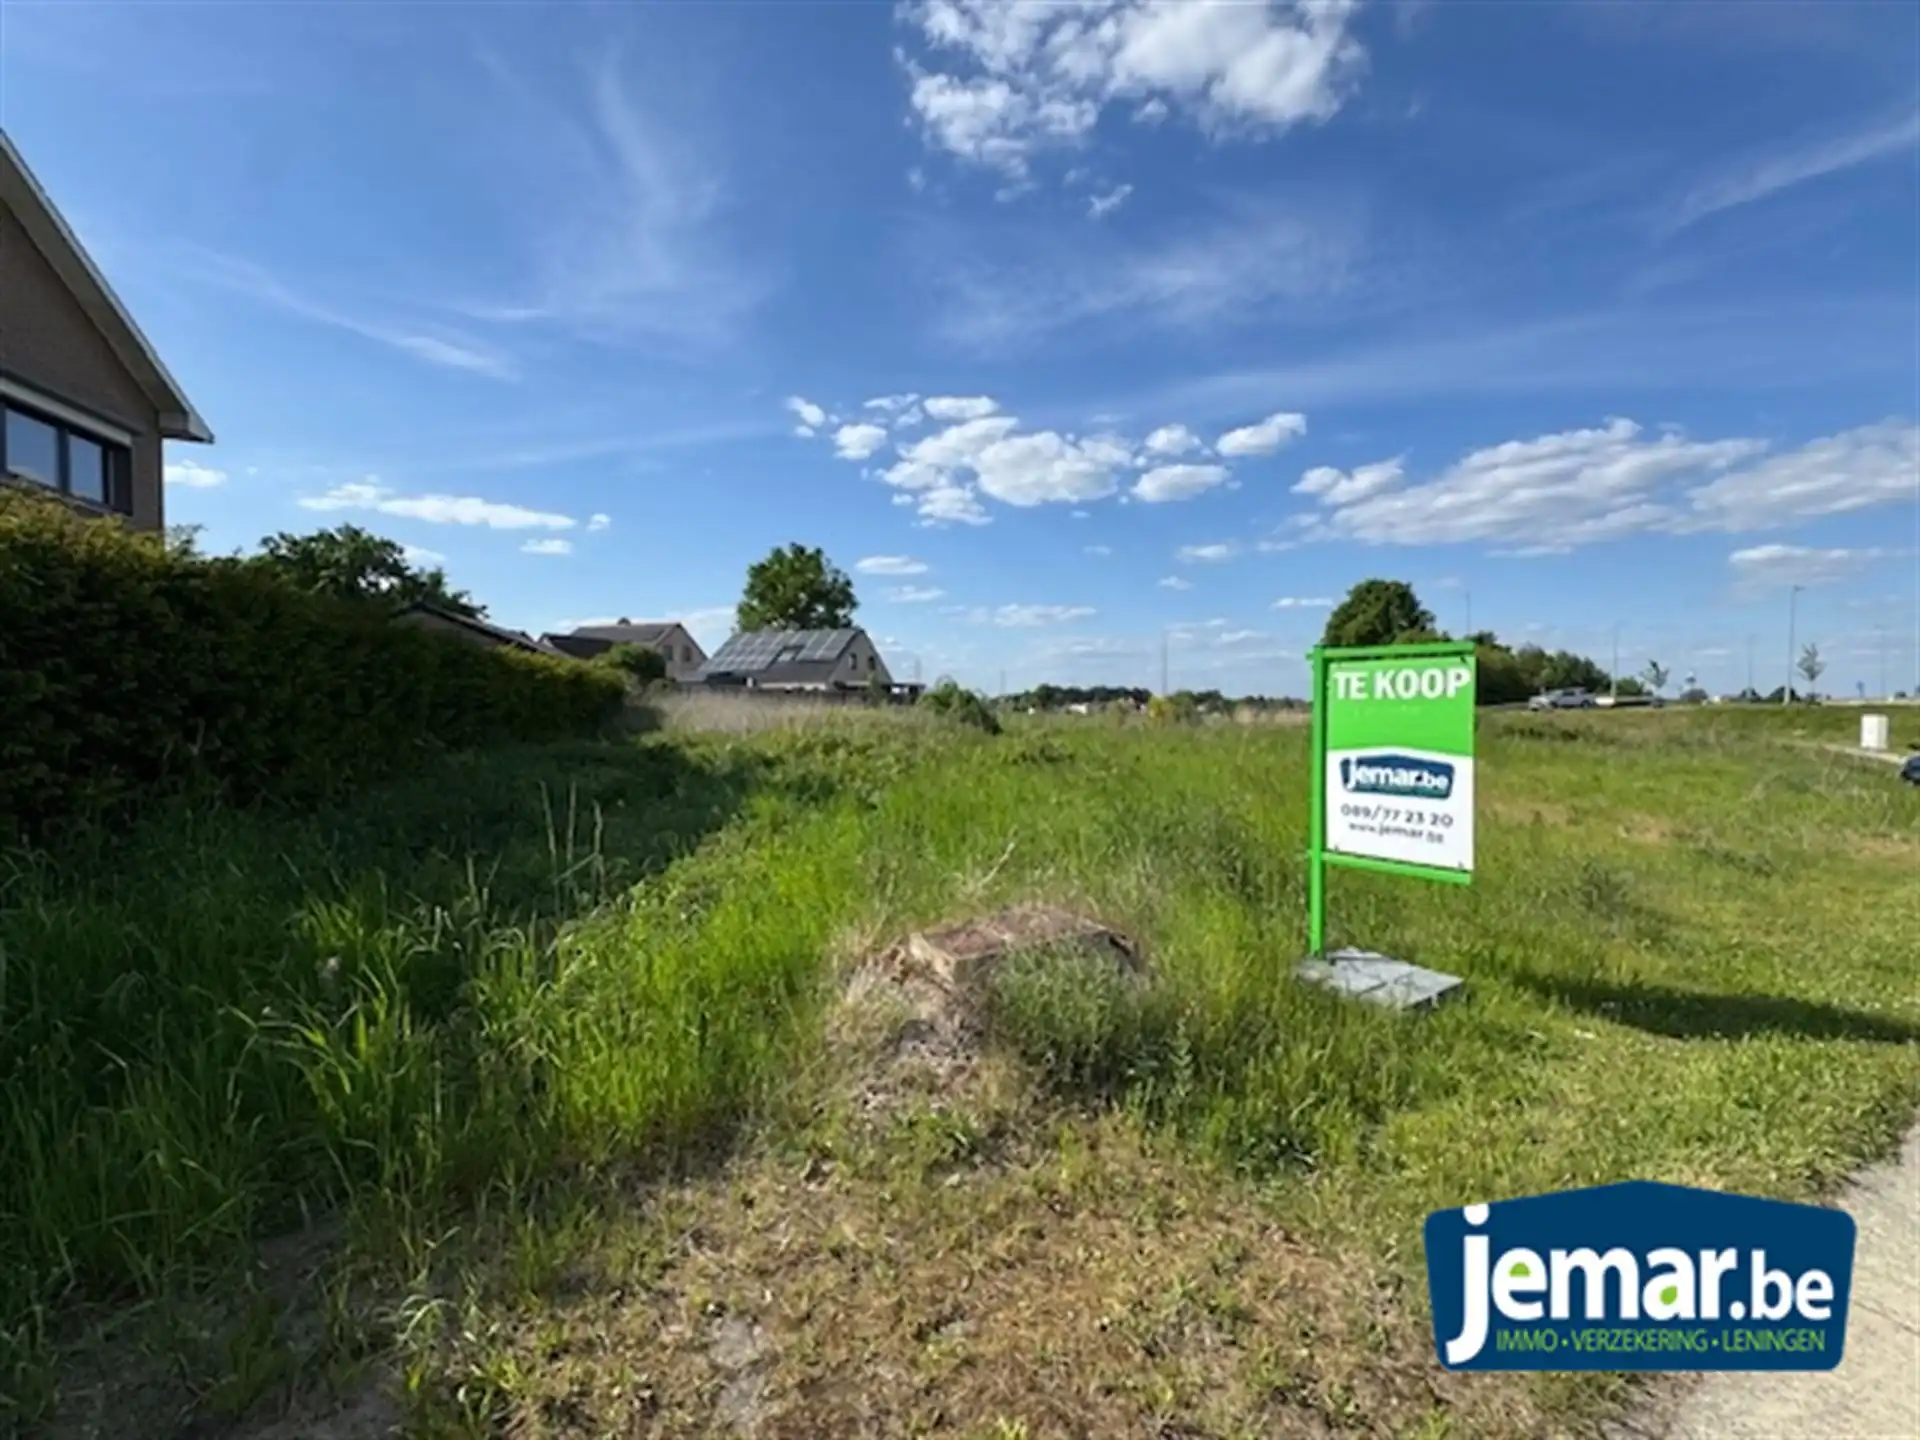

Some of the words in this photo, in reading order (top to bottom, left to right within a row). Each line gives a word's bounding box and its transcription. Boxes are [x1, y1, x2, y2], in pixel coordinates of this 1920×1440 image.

[1333, 671, 1369, 699] TE
[1375, 668, 1471, 700] KOOP
[1347, 758, 1449, 790] jemar.be
